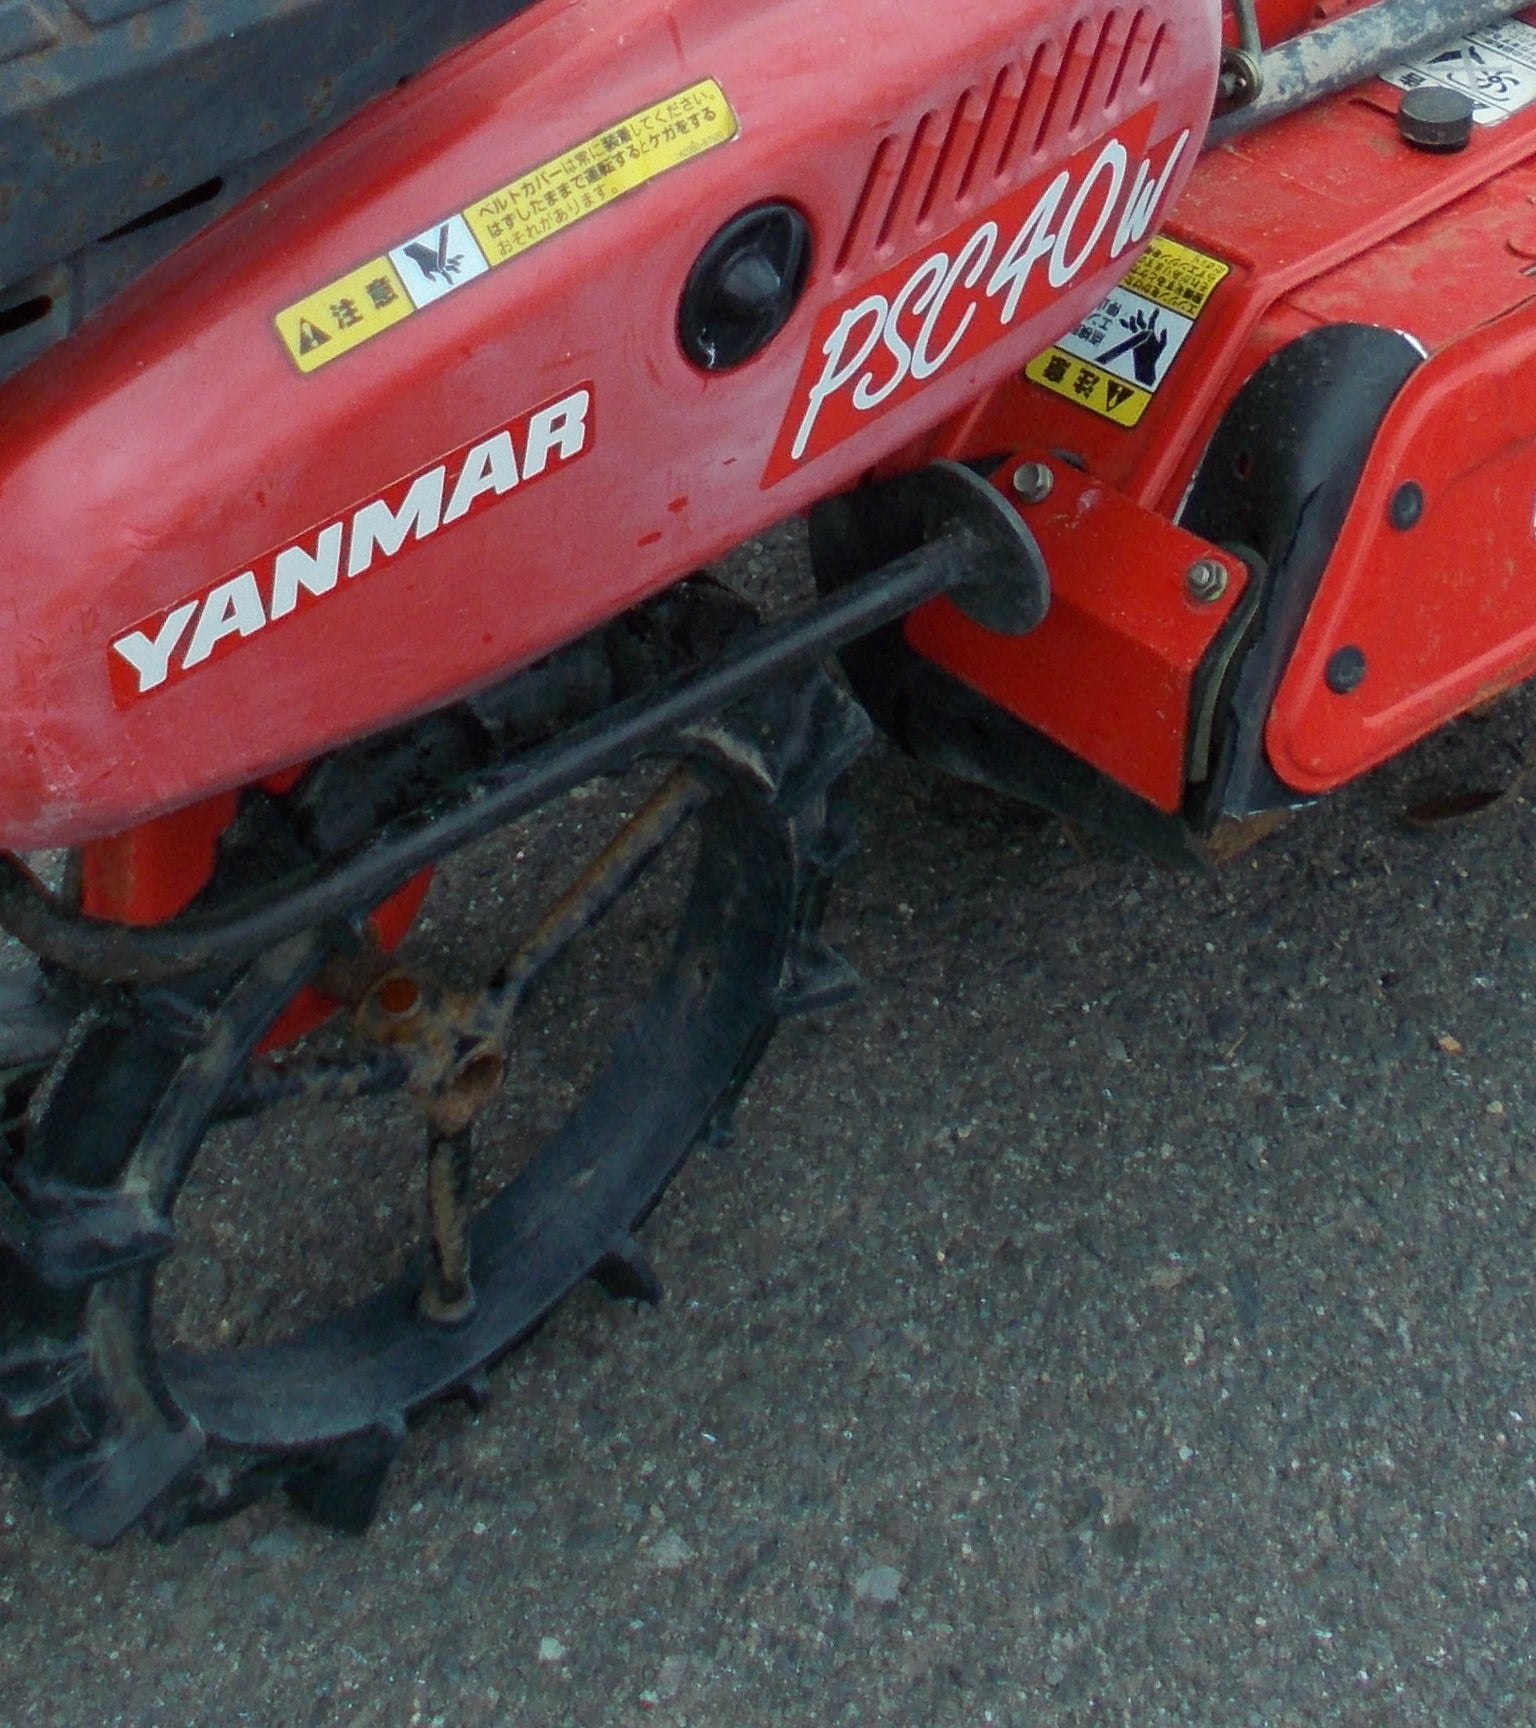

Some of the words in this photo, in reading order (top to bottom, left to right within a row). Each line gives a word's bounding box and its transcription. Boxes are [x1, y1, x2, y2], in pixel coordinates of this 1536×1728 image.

[477, 87, 716, 218] ベルトカバーは常に装着してください。
[487, 107, 717, 237] はずしたままで運転するとケガをする
[498, 183, 620, 256] おそれがあります。
[330, 275, 398, 331] 注意
[1041, 354, 1101, 400] 注意
[109, 387, 592, 692] YANMAR
